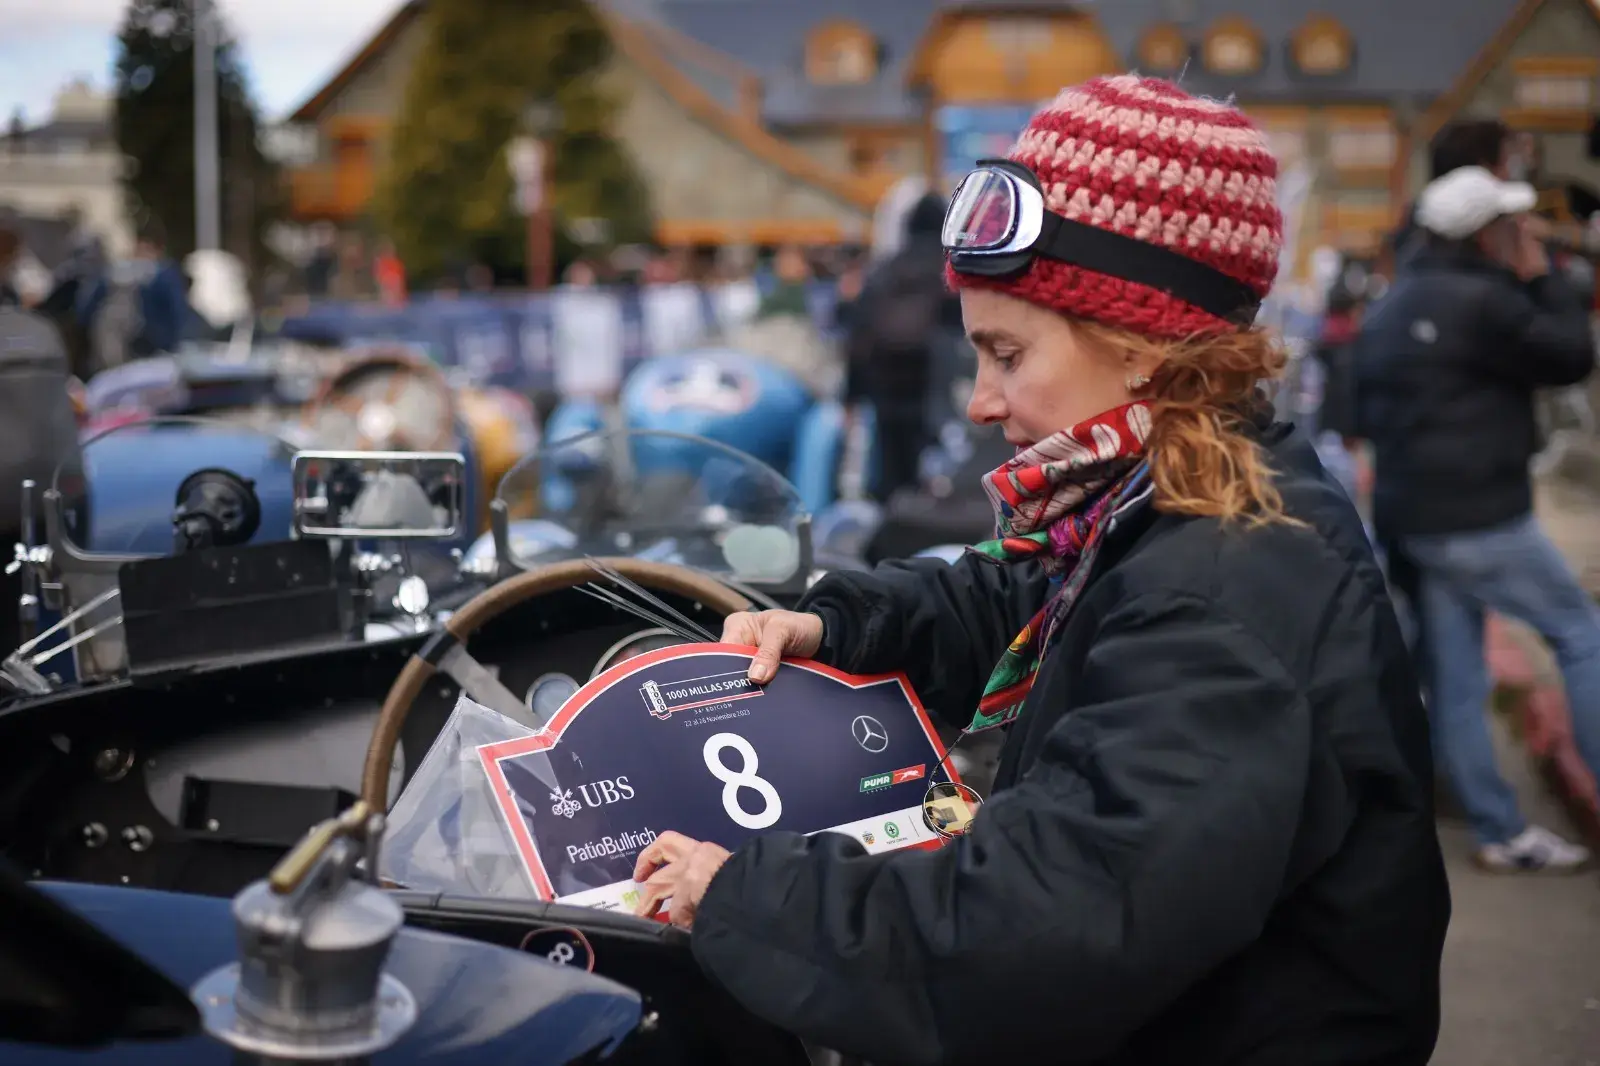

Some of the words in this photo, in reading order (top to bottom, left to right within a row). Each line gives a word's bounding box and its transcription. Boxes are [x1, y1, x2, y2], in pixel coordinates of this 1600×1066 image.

[666, 689, 688, 700] 1000
[688, 682, 723, 696] MILLAS
[723, 678, 752, 691] SPORT
[699, 717, 707, 725] 26
[706, 712, 737, 723] Noviembre
[736, 709, 751, 717] 2023
[578, 775, 635, 808] UBS
[702, 732, 782, 830] 8
[863, 775, 891, 789] PUMA
[566, 826, 658, 864] PatioBullrich
[548, 942, 574, 967] 8
